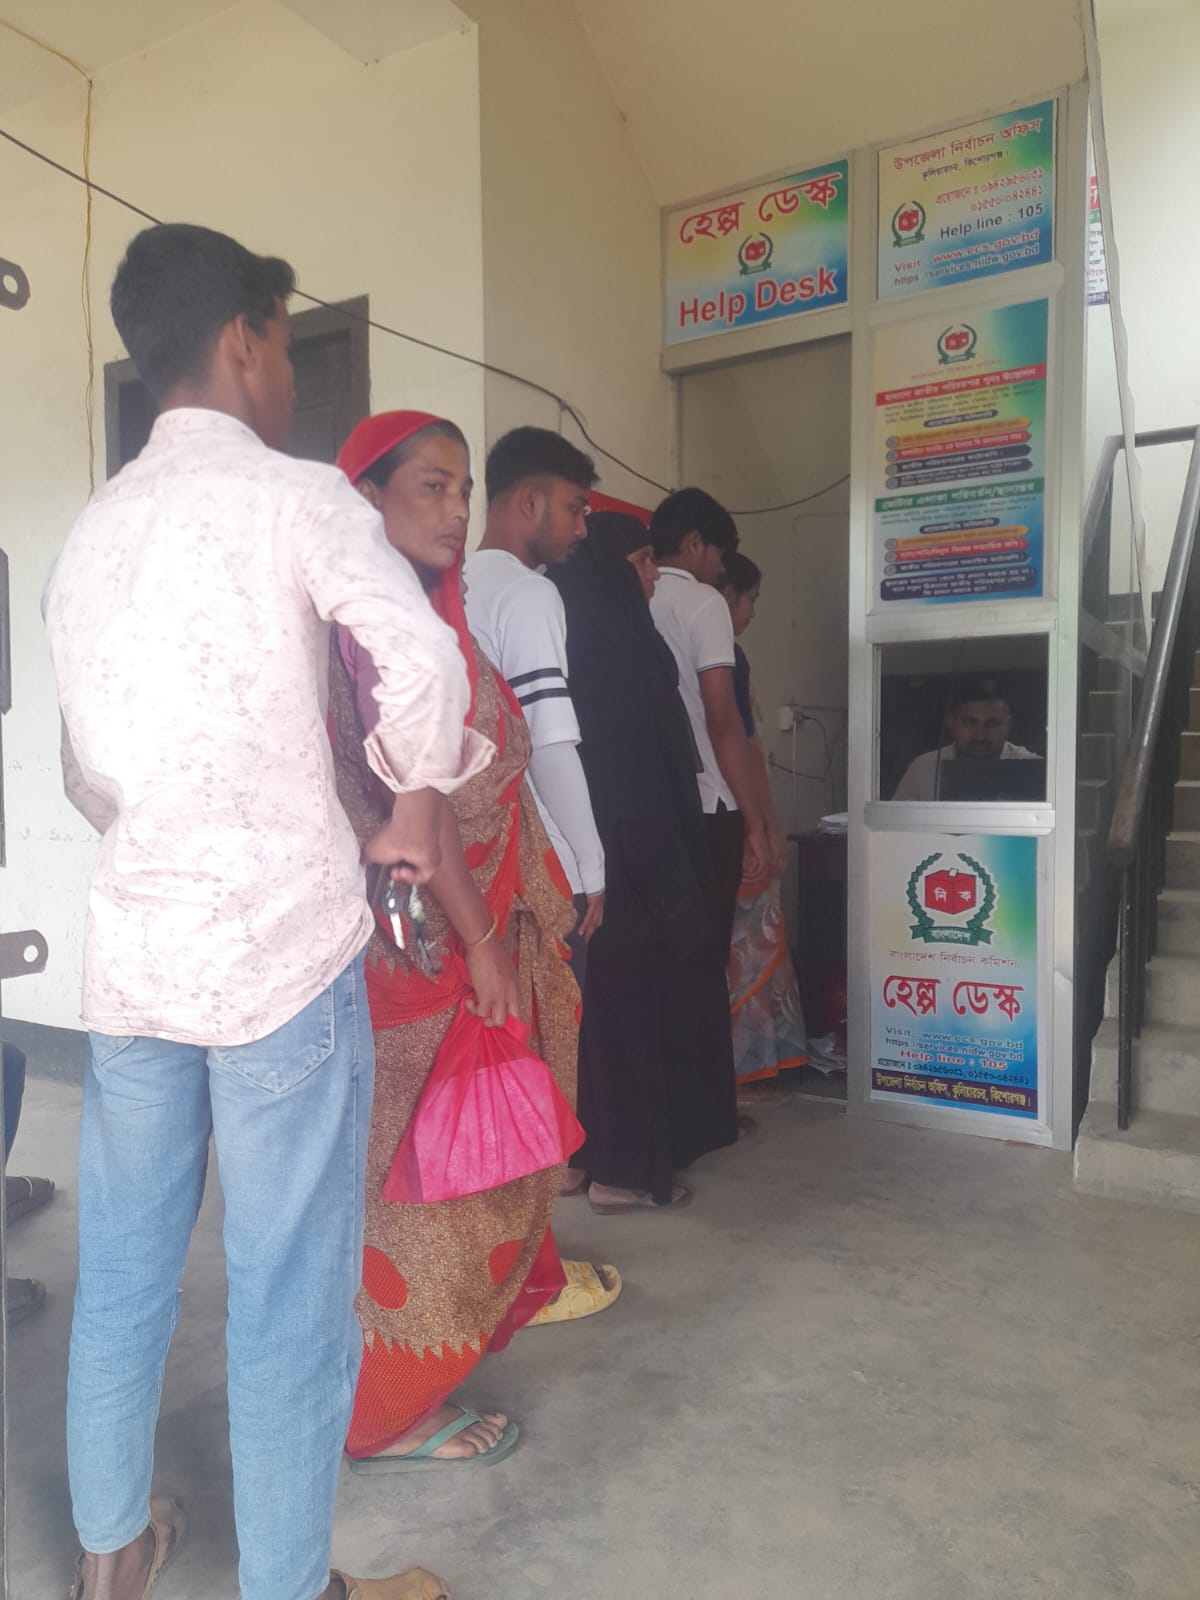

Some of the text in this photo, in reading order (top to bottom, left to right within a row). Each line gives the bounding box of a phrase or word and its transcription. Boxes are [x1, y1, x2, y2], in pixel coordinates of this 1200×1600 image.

[893, 119, 1040, 170] উপজেলা নির্বাচন অফিস
[680, 174, 841, 244] হেল্প ডেস্ক
[940, 224, 972, 239] Help
[977, 215, 1002, 230] line
[1018, 203, 1043, 219] 105
[894, 260, 920, 272] Visit
[680, 267, 835, 327] Help Desk
[934, 887, 971, 903] নি ক
[930, 930, 971, 942] বাংলাদেশ
[888, 951, 1018, 968] বাংলাদেশ নির্বাচন কমিশন
[883, 976, 1024, 1023] হেল্প ডেস্ক
[886, 1026, 1023, 1049] Visit www.ecs.gov.bd
[900, 1050, 933, 1061] Help
[938, 1054, 964, 1065] line
[981, 1059, 1007, 1069] 105
[876, 1072, 902, 1087] উপজেলা
[904, 1075, 926, 1090] নির্বাচন
